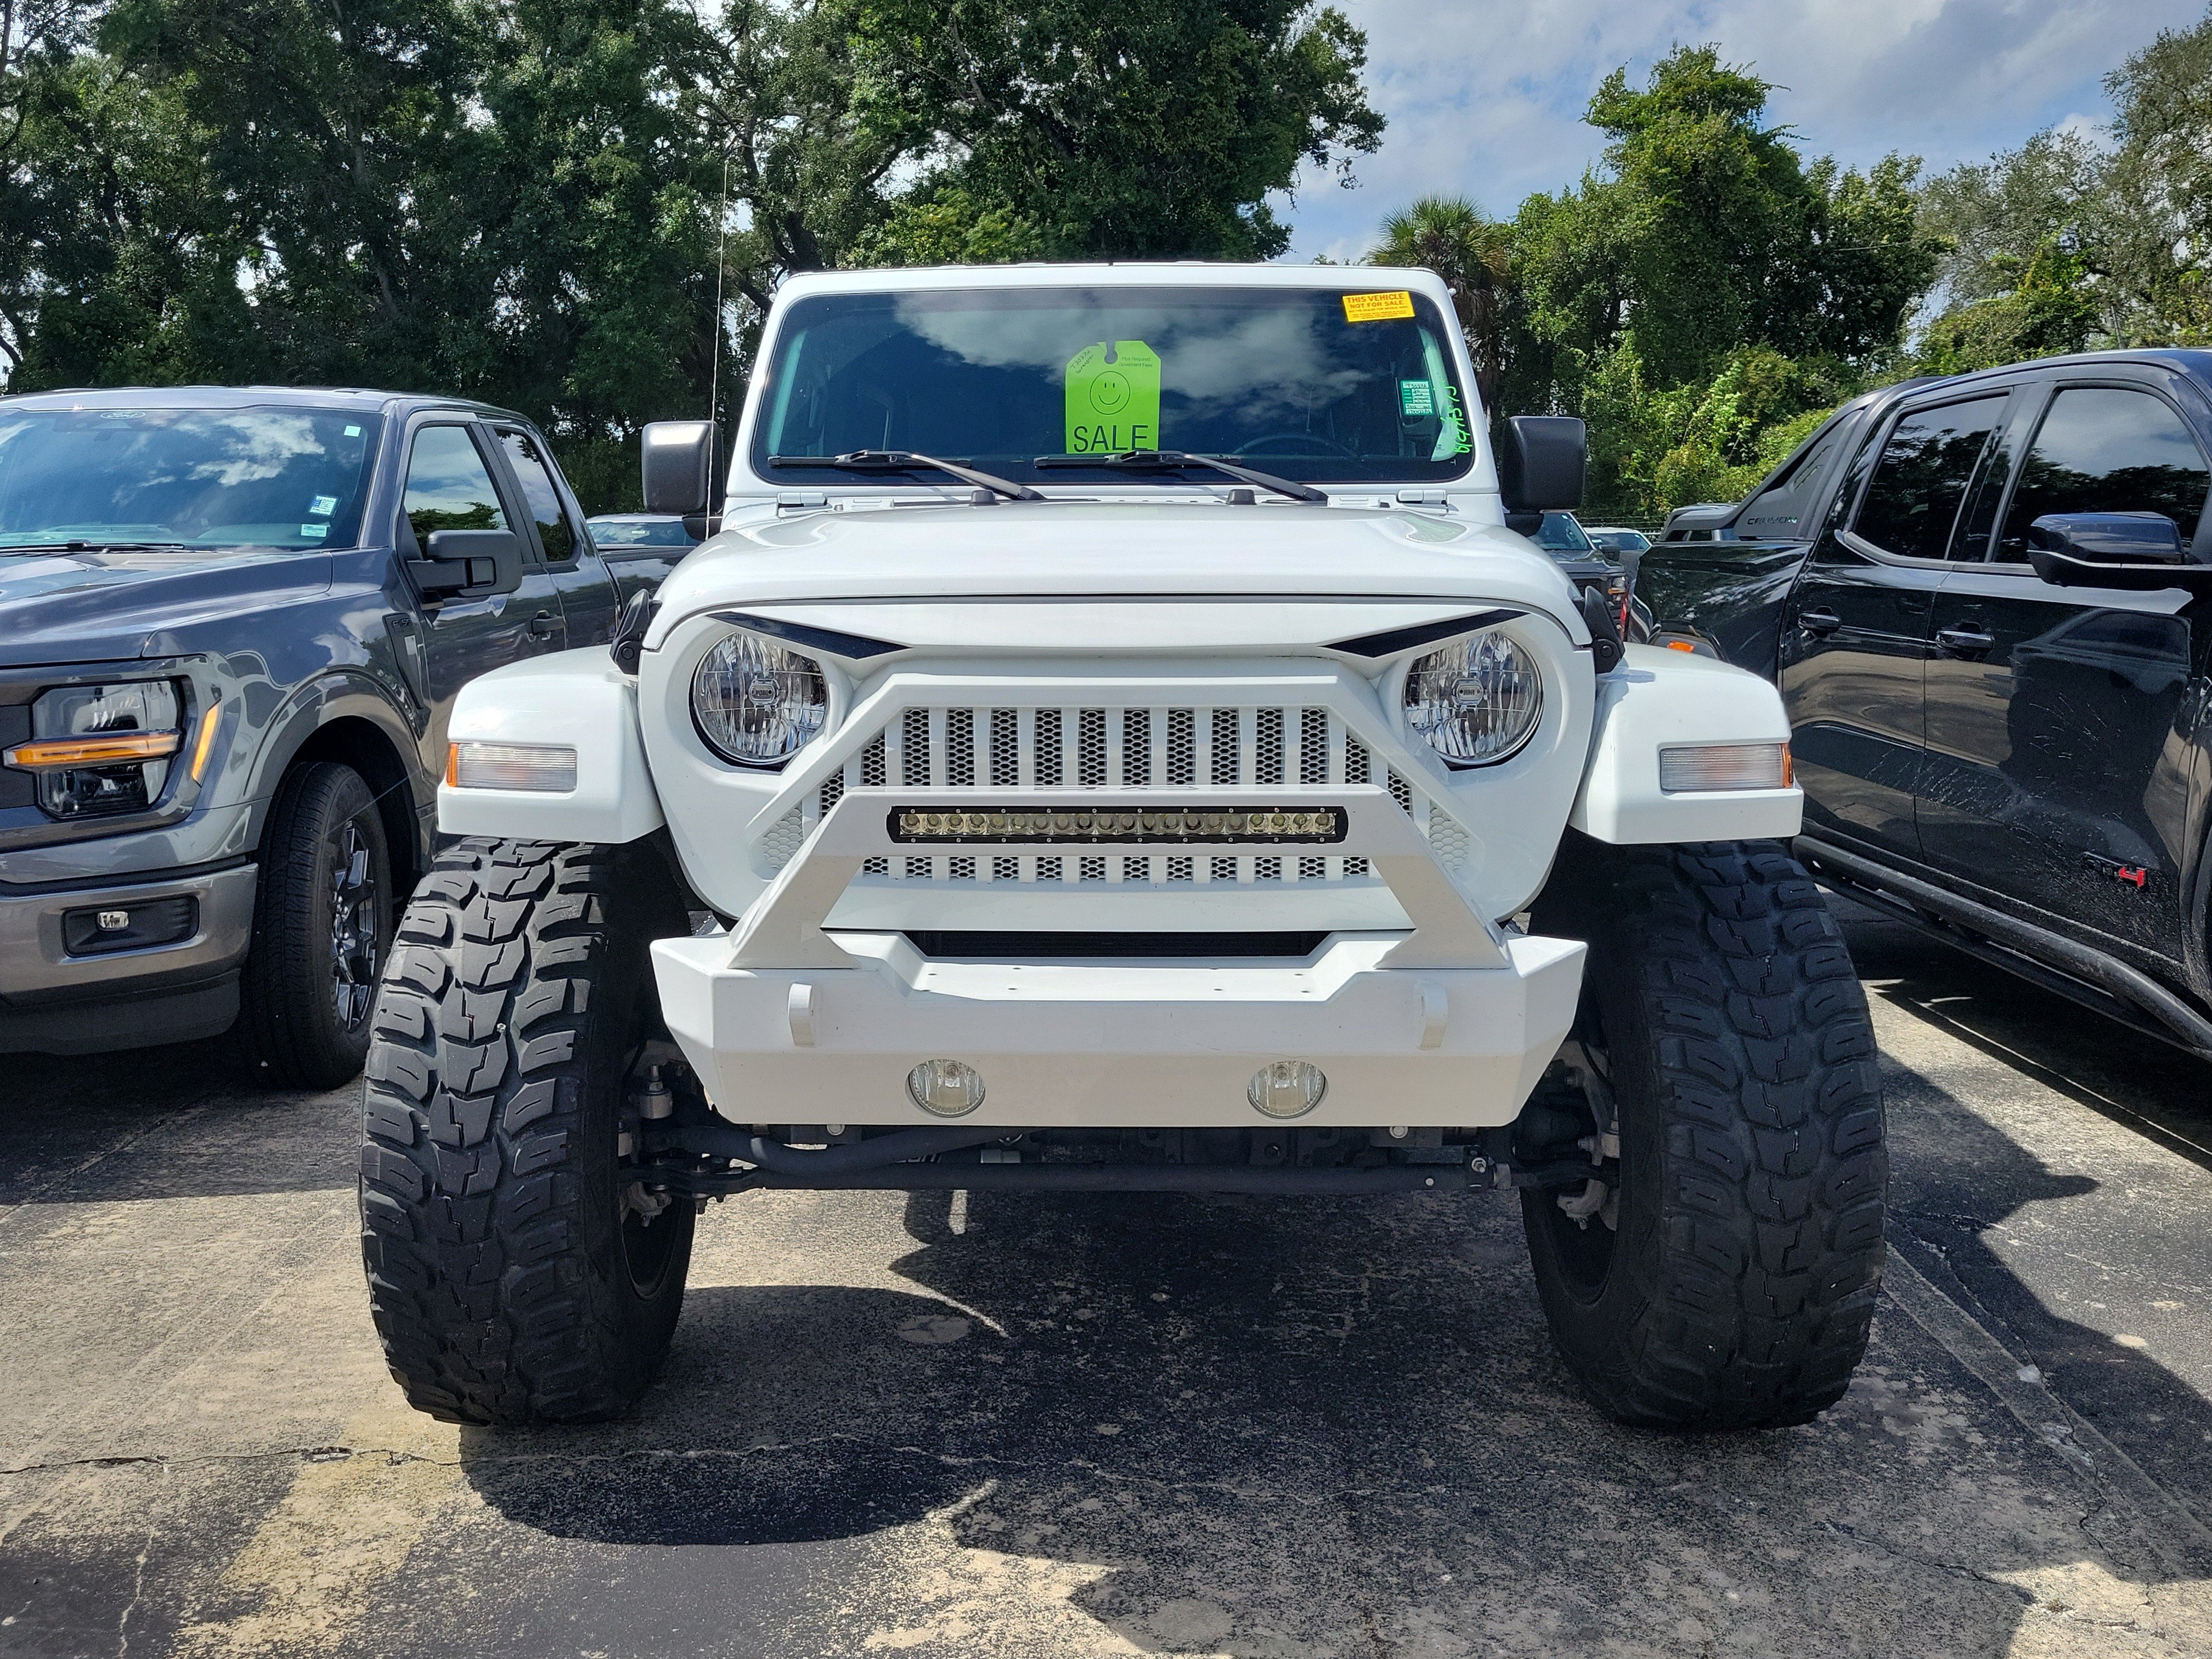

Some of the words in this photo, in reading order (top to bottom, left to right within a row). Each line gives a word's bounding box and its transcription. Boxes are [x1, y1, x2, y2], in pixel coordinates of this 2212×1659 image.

[1367, 293, 1404, 302] VEHICLE
[1074, 425, 1148, 453] SALE
[1747, 516, 1798, 525] CANYON
